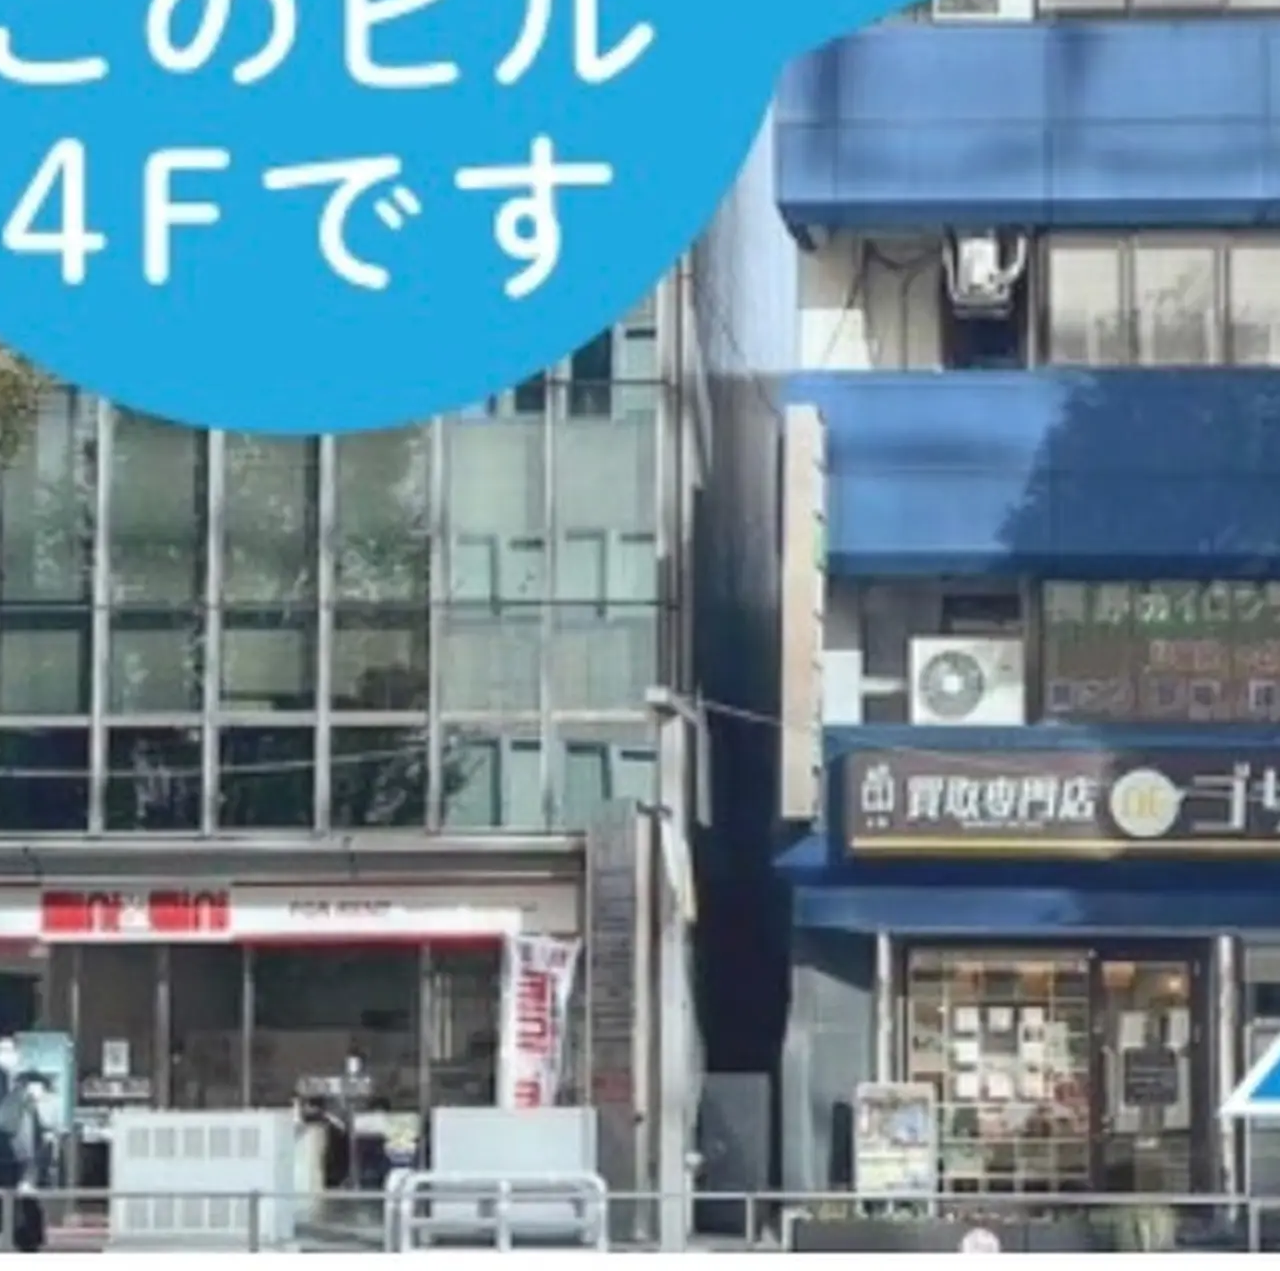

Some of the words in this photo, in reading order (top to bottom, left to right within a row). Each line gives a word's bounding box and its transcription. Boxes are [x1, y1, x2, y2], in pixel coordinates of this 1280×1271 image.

[906, 774, 1096, 821] 買取専門店
